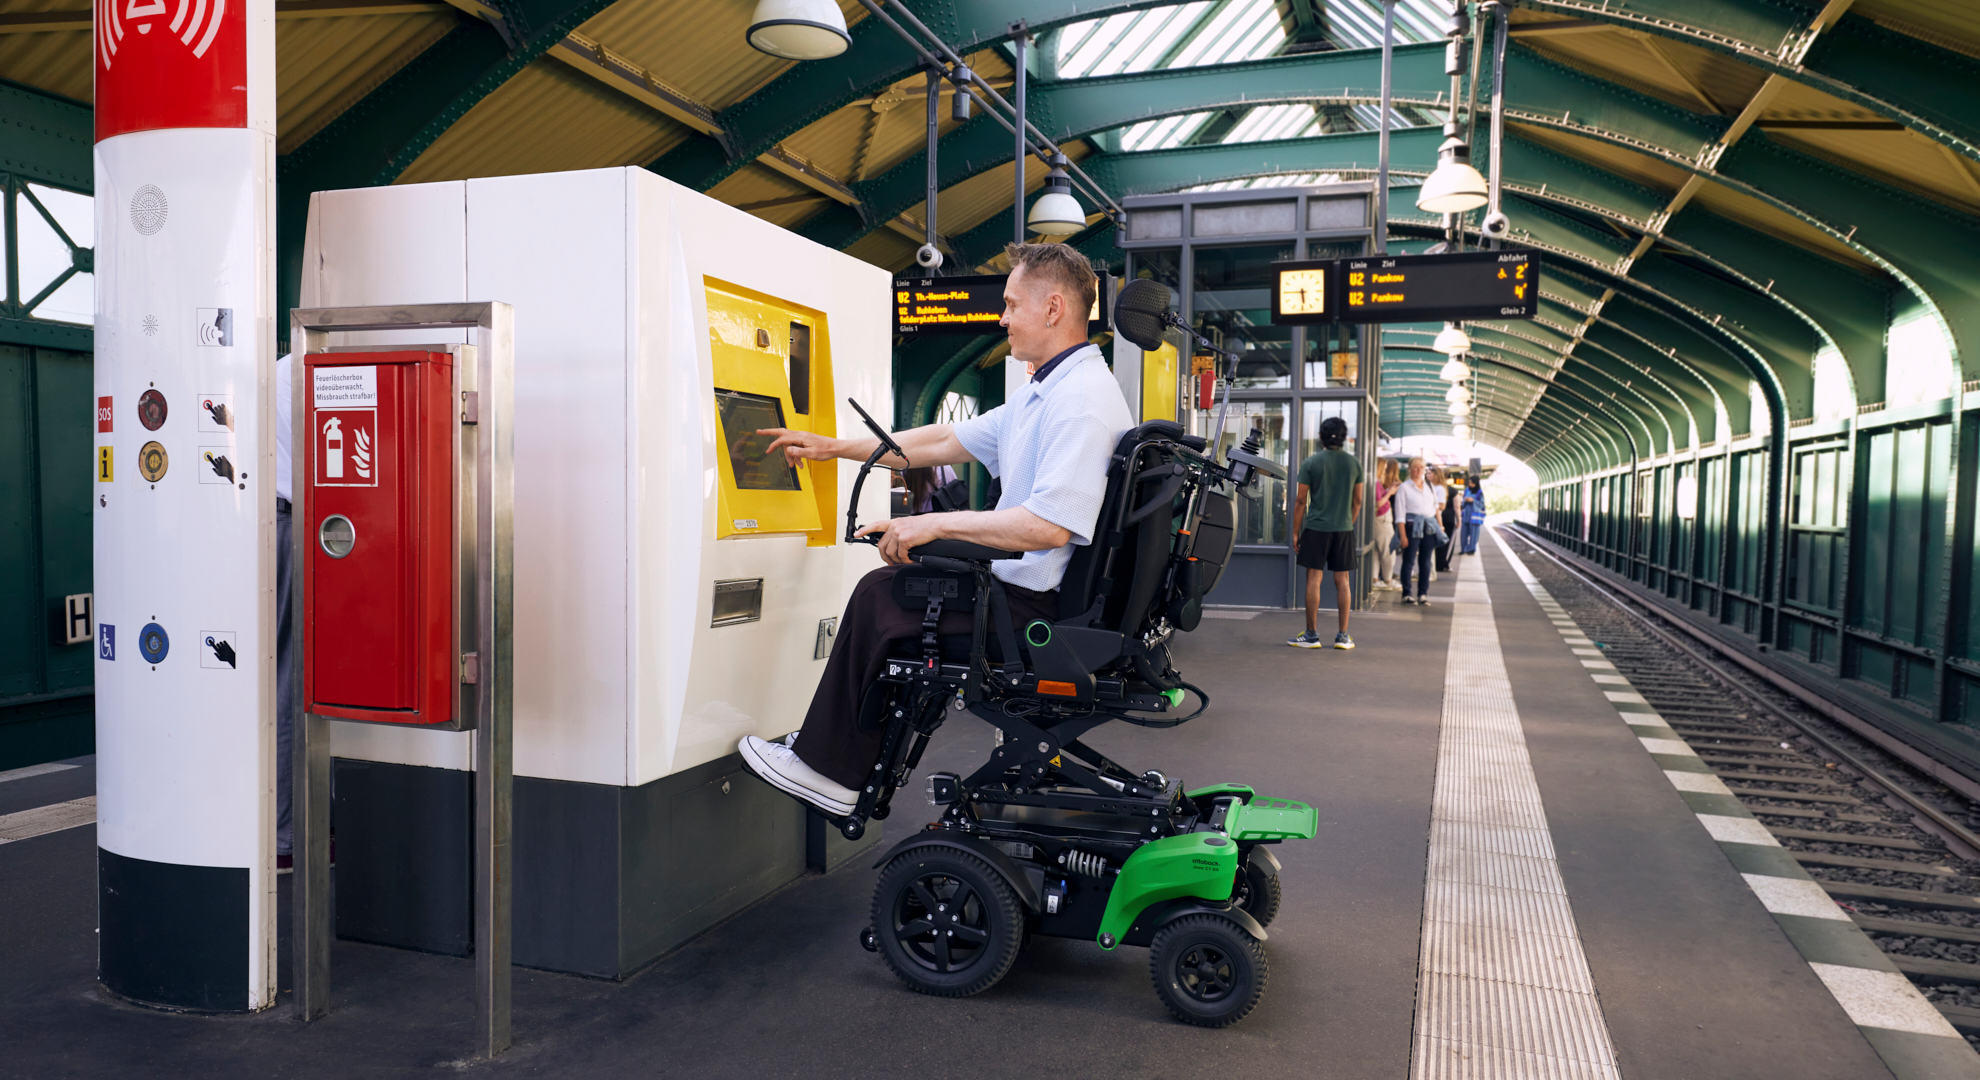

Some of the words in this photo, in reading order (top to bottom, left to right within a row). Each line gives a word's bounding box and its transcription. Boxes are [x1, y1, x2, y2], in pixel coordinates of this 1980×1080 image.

[1382, 260, 1395, 268] Ziel
[1498, 254, 1528, 262] Abfahrt
[1349, 272, 1365, 286] U2
[1372, 273, 1404, 283] Pankow
[897, 292, 910, 304] U2
[1349, 292, 1365, 305] U2
[1371, 293, 1404, 303] Pankow
[898, 307, 908, 315] U2
[916, 306, 948, 314] Ruhleben
[99, 408, 112, 421] SOS
[70, 597, 91, 638] H
